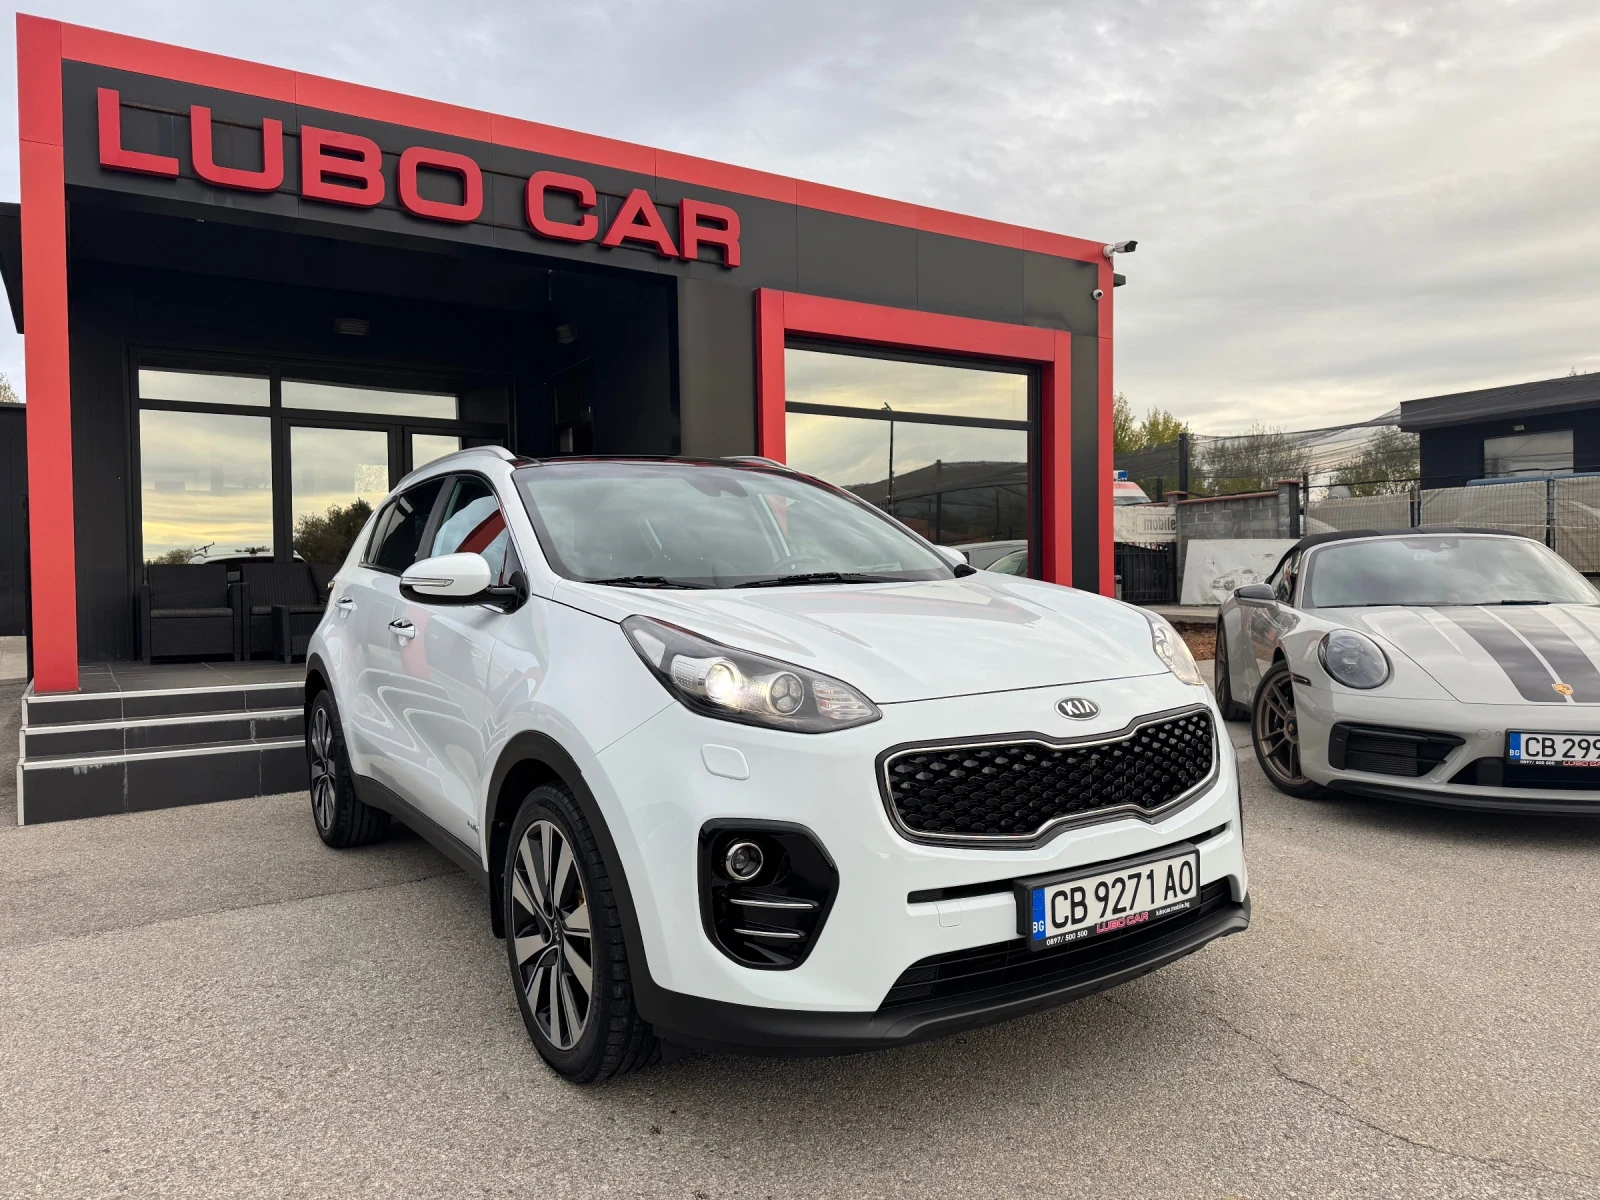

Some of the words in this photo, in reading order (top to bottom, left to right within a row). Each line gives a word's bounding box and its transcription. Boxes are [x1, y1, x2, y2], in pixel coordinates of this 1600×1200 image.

[97, 87, 485, 225] LUBO
[525, 170, 741, 269] CAR
[1144, 516, 1176, 531] mobile
[1060, 699, 1097, 716] KIA
[1525, 737, 1556, 757] CB
[1051, 886, 1088, 929] CB
[1094, 869, 1155, 918] 9271
[1164, 860, 1194, 901] AO
[1033, 920, 1045, 933] BG
[1096, 915, 1126, 933] LUBO
[1126, 911, 1149, 926] CAR
[1065, 931, 1076, 941] 500
[1077, 929, 1088, 938] 500
